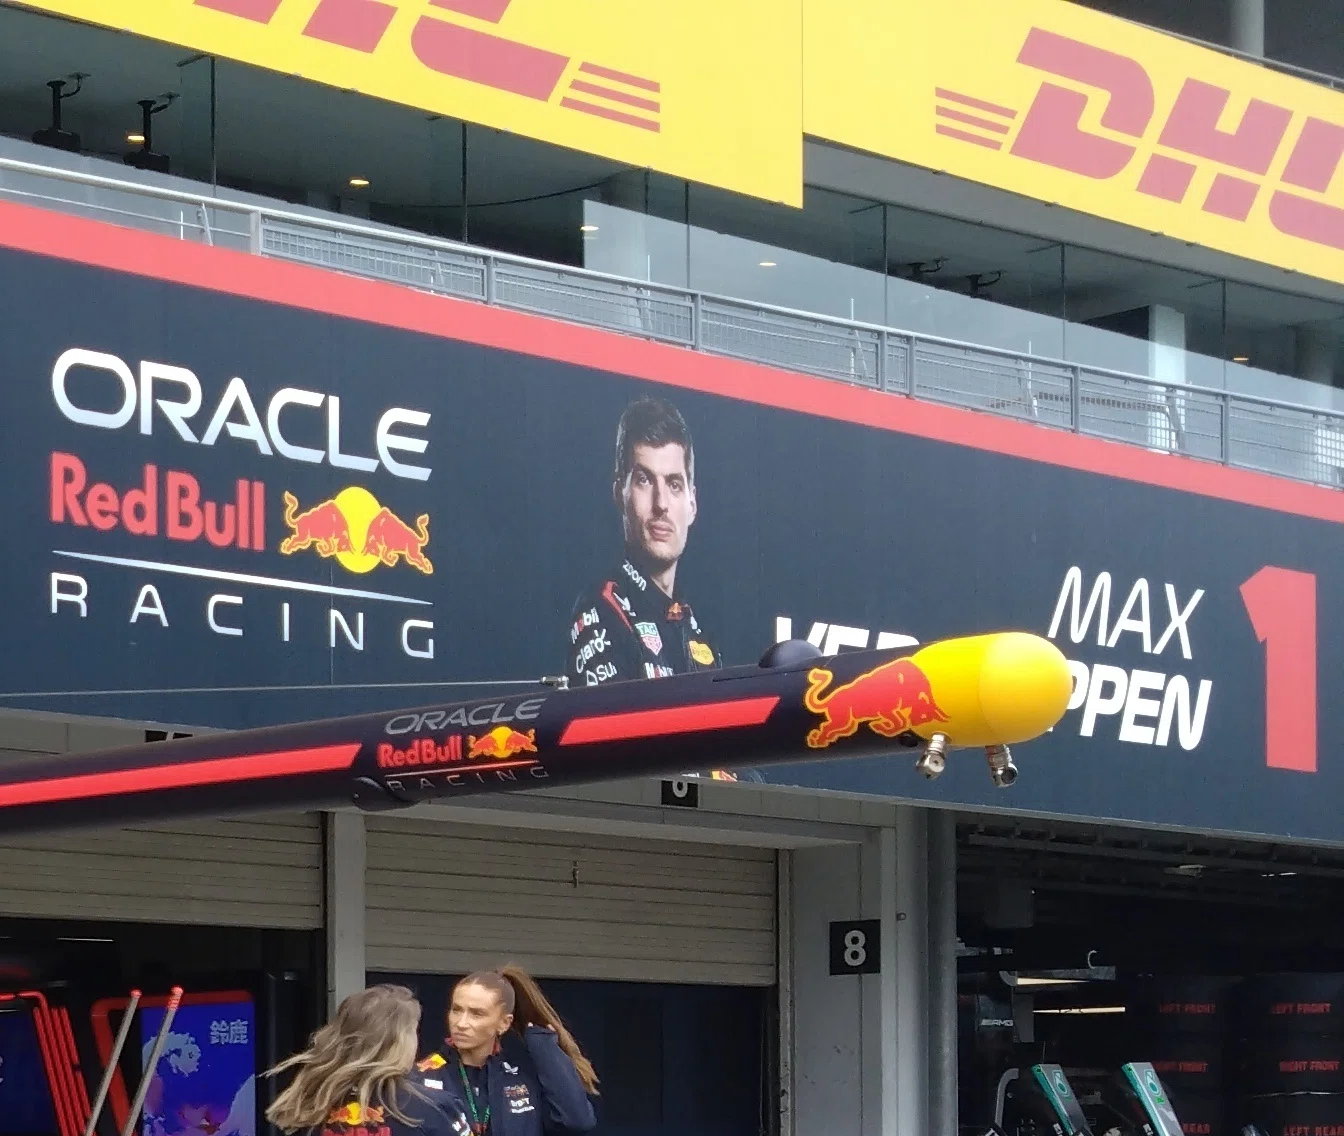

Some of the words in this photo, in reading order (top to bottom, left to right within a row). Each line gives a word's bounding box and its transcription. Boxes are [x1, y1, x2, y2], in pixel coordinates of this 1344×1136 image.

[51, 348, 432, 481] ORACLE
[49, 451, 158, 537] Red
[166, 469, 267, 553] Bull
[622, 559, 647, 592] zoom
[50, 572, 434, 660] RACING
[1048, 566, 1205, 660] MAX
[1239, 565, 1318, 773] 1
[384, 698, 546, 735] ORACLE
[386, 764, 550, 792] RACING
[843, 930, 867, 967] 8
[1297, 1003, 1332, 1014] FRONT
[209, 1018, 249, 1045] 鈴鹿
